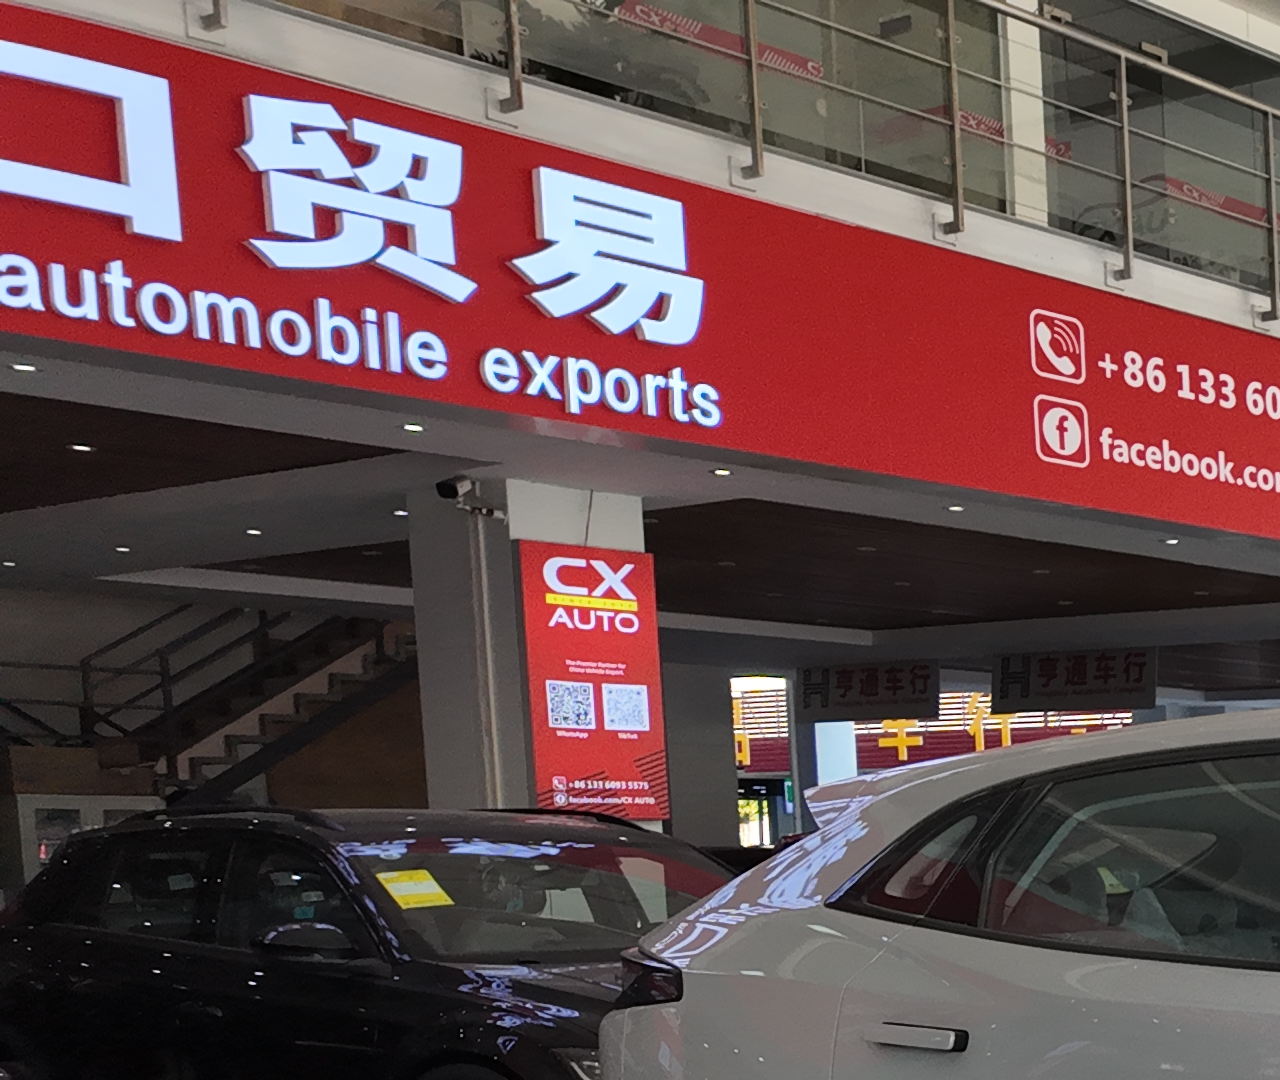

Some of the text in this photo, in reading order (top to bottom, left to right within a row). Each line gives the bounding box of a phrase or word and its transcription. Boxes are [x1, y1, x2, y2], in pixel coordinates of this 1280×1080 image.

[0, 254, 723, 428] automobile exports
[1098, 351, 1166, 393] +86
[1176, 364, 1237, 408] 133
[543, 556, 637, 600] CX
[548, 606, 640, 633] AUTO
[1037, 652, 1147, 688] 亨通车行
